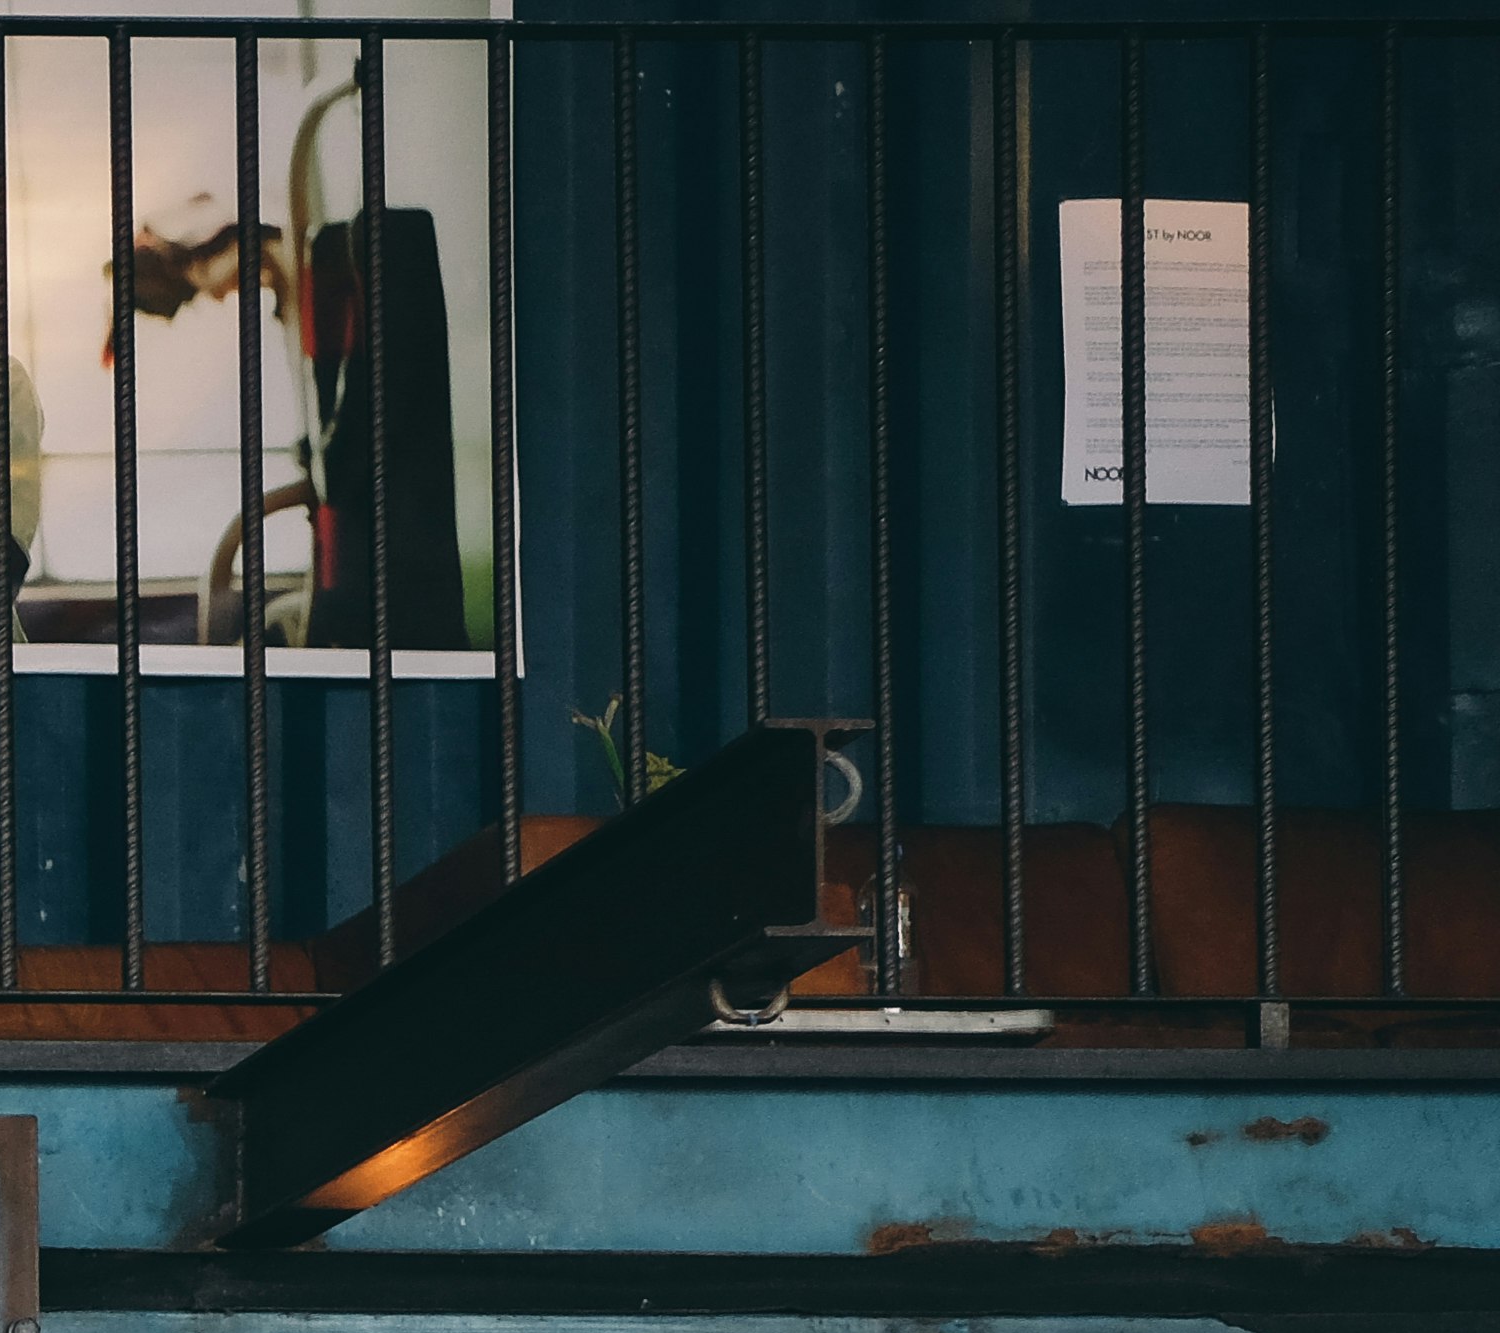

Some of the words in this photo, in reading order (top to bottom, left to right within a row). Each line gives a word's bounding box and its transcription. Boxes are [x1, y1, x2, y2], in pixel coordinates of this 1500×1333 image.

[1162, 229, 1175, 243] by
[1177, 231, 1212, 242] NOOR
[1085, 467, 1124, 482] NOO
